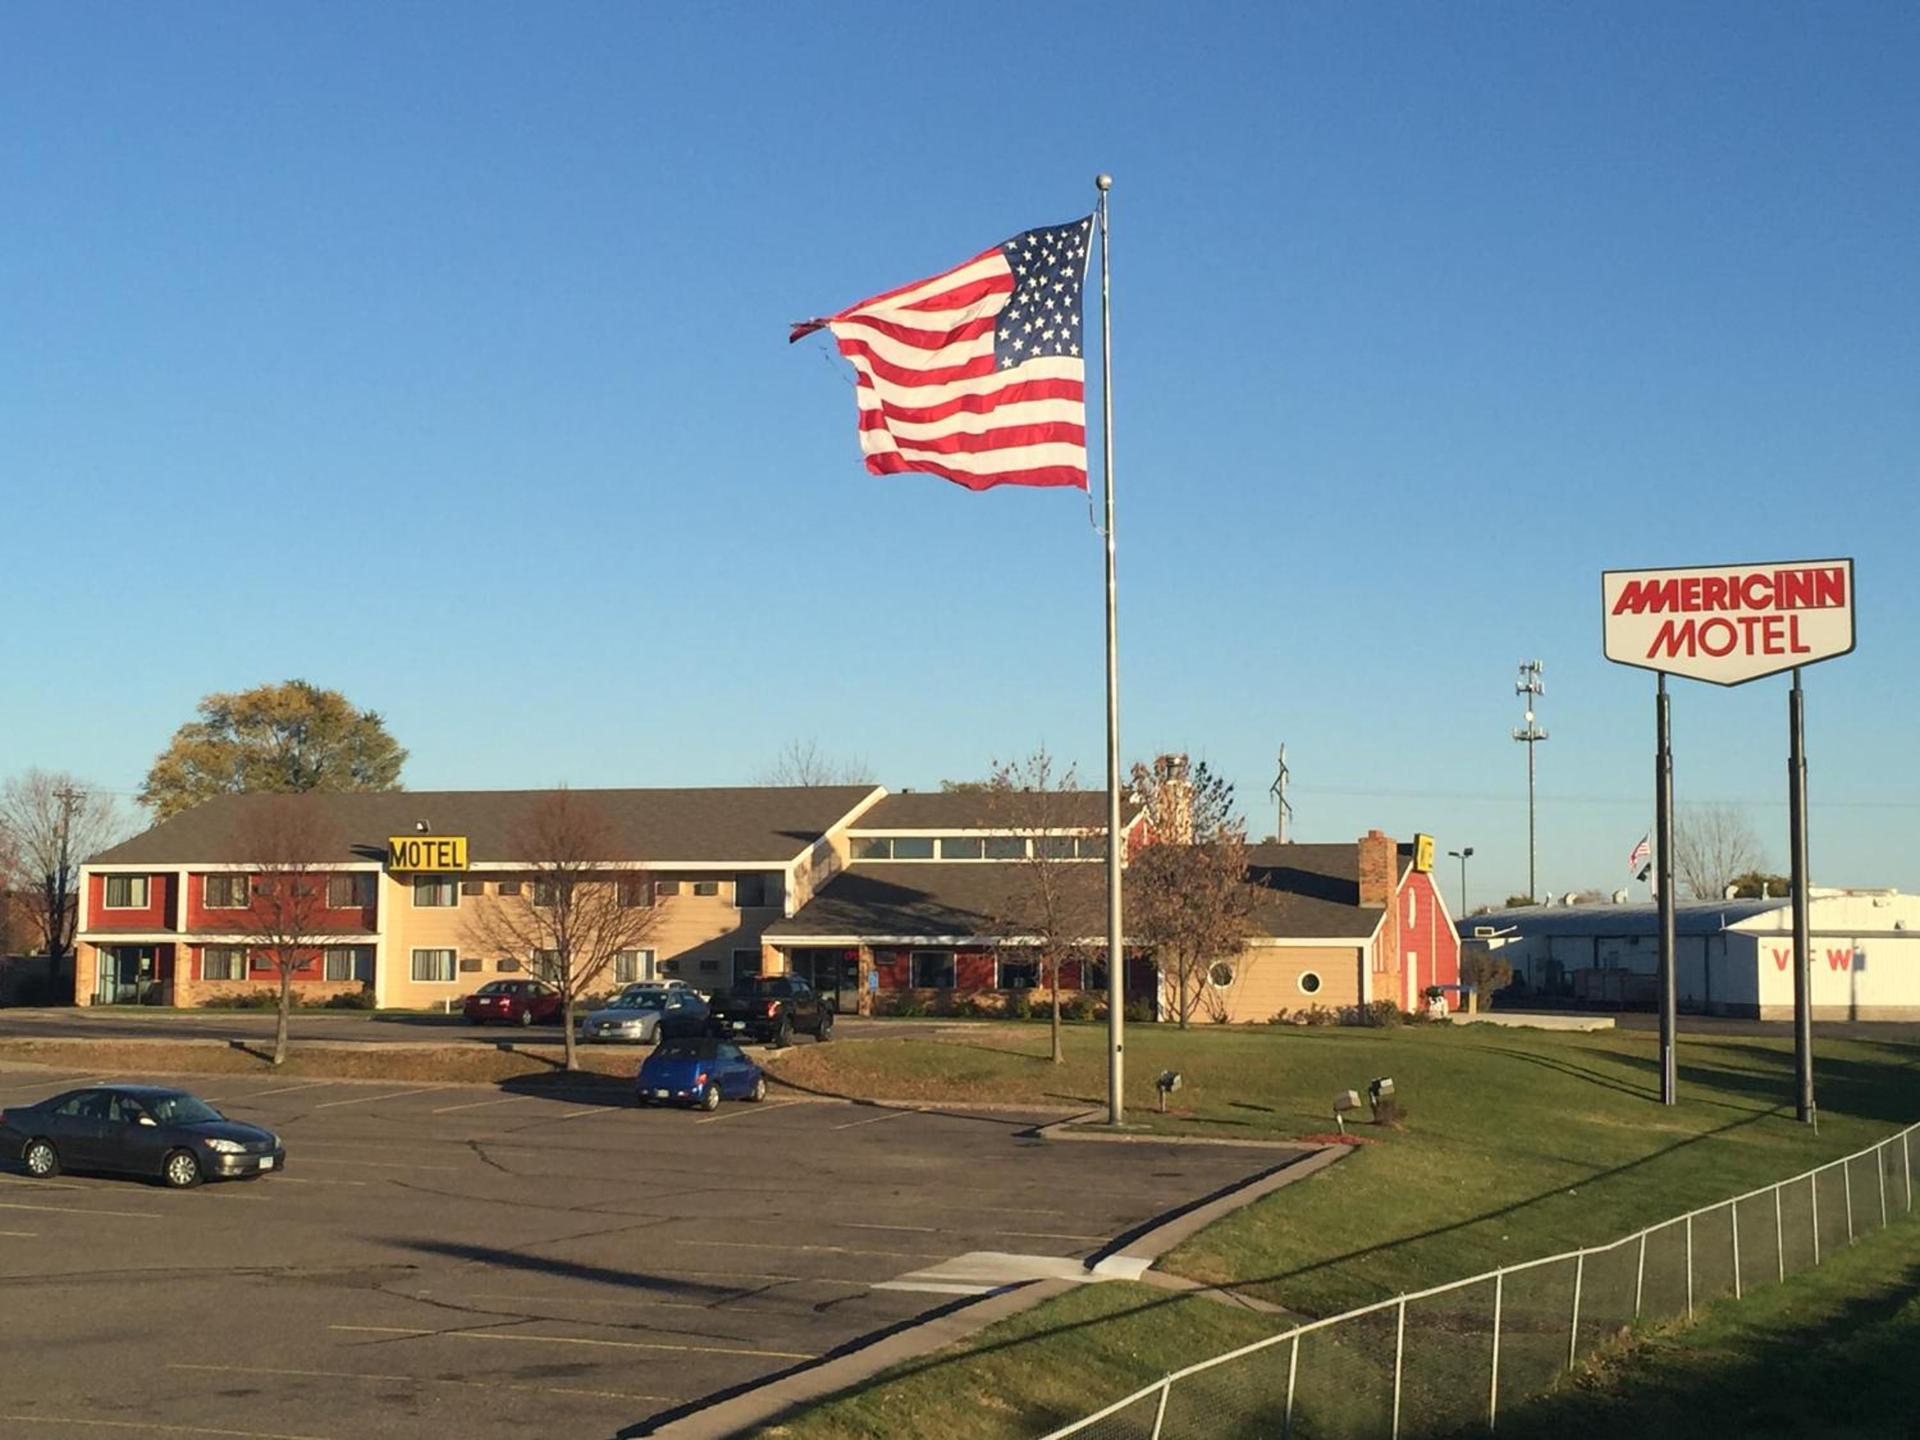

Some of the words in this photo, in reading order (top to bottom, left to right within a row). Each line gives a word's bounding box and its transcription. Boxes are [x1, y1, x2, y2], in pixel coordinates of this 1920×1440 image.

[1612, 567, 1845, 615] AMERICINN
[1646, 615, 1811, 659] MOTEL
[389, 841, 463, 867] MOTEL
